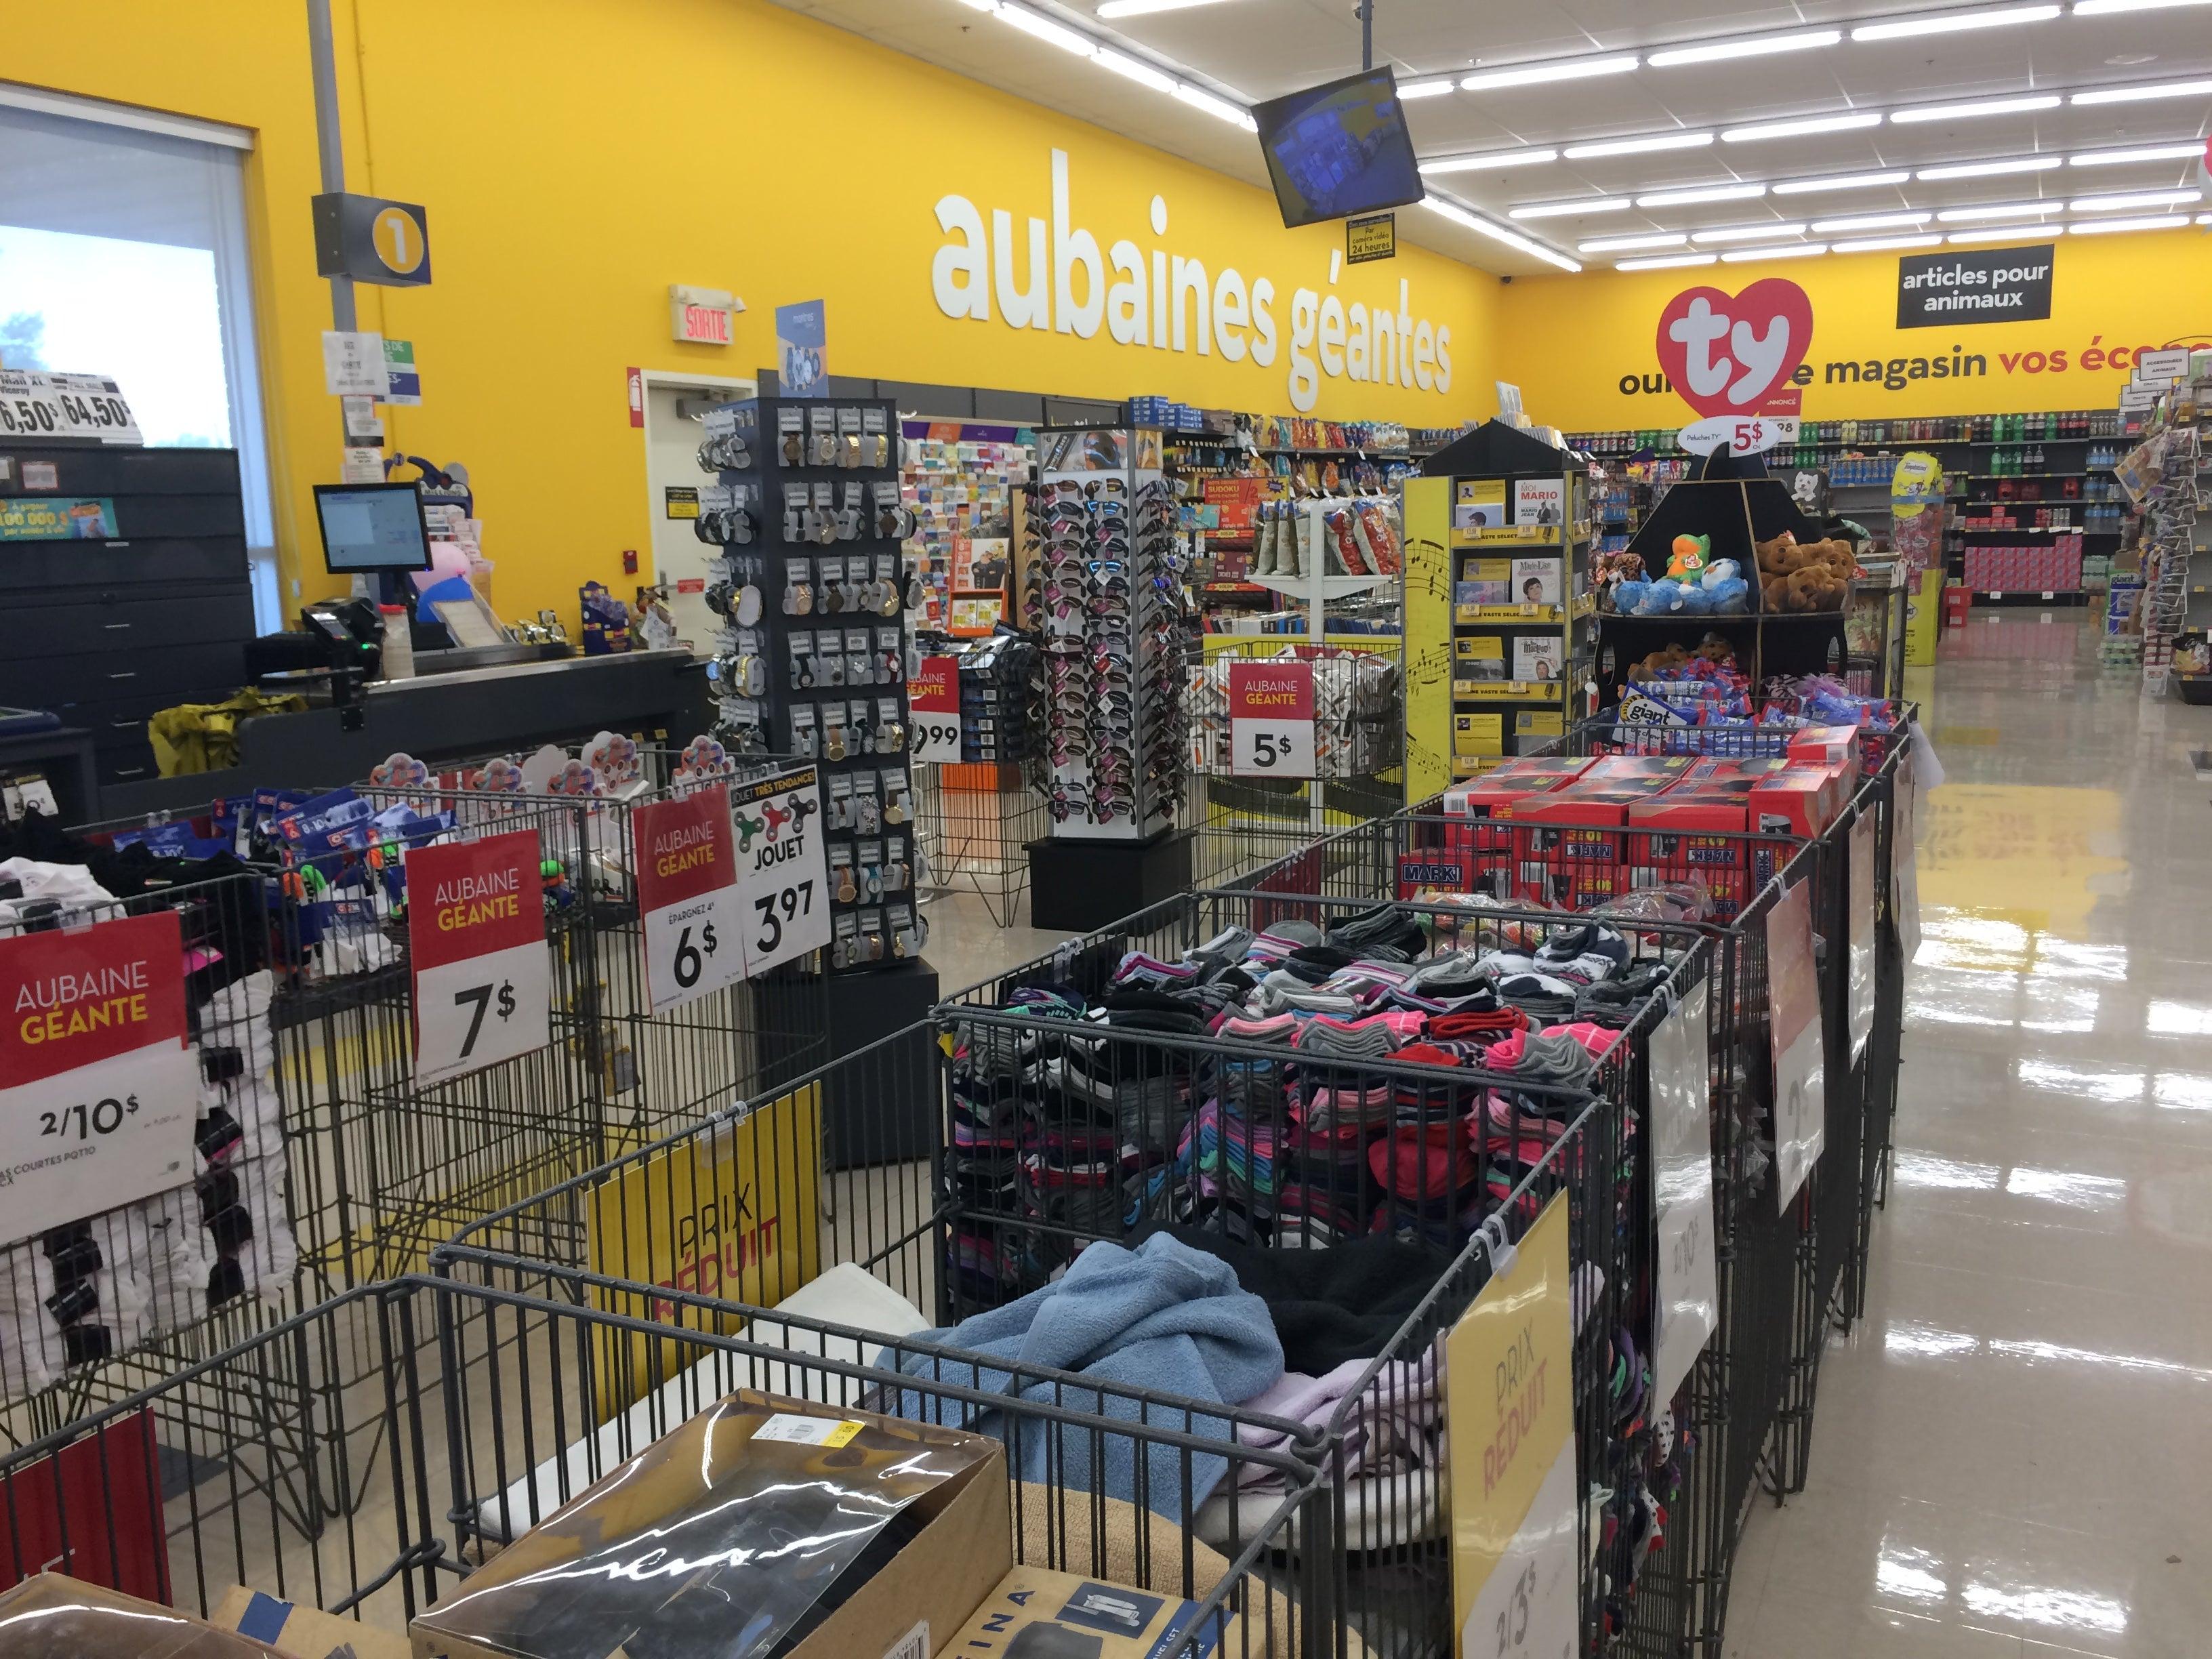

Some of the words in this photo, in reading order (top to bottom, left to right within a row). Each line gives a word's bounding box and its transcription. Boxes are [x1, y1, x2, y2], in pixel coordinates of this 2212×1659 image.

[386, 218, 407, 264] 1
[1353, 245, 1362, 254] 24
[1365, 242, 1390, 252] heures
[932, 147, 1277, 367] aubaines
[1289, 249, 1452, 412] géantes
[1903, 263, 1988, 289] articles
[1992, 263, 2049, 289] pour
[1924, 289, 2024, 311] animaux
[685, 305, 729, 342] SORTIE
[1669, 296, 1790, 405] ty
[1825, 344, 1986, 390] magasin
[1999, 349, 2068, 375] vos
[1521, 491, 1558, 500] MARIO
[1244, 680, 1298, 692] AUBAINE
[1246, 690, 1296, 705] GÉANTE
[1629, 703, 1671, 725] giant
[1252, 733, 1292, 769] 5$
[754, 781, 773, 797] TRÈS
[653, 820, 715, 856] AUBAINE
[754, 834, 805, 872] JOUET
[655, 843, 716, 878] GÉANTE
[434, 867, 520, 906] AUBAINE
[437, 894, 520, 932] GÉANTE
[673, 919, 718, 989] 6$
[14, 960, 150, 1013] AUBAINE
[20, 994, 149, 1045] GÉANTE
[454, 978, 516, 1059] 7$
[14, 1154, 62, 1175] COURTES
[678, 1182, 754, 1259] PRIX
[654, 1216, 778, 1320] RÉDUIT
[1495, 1317, 1536, 1408] PRIX
[1481, 1357, 1548, 1502] RÉDUIT
